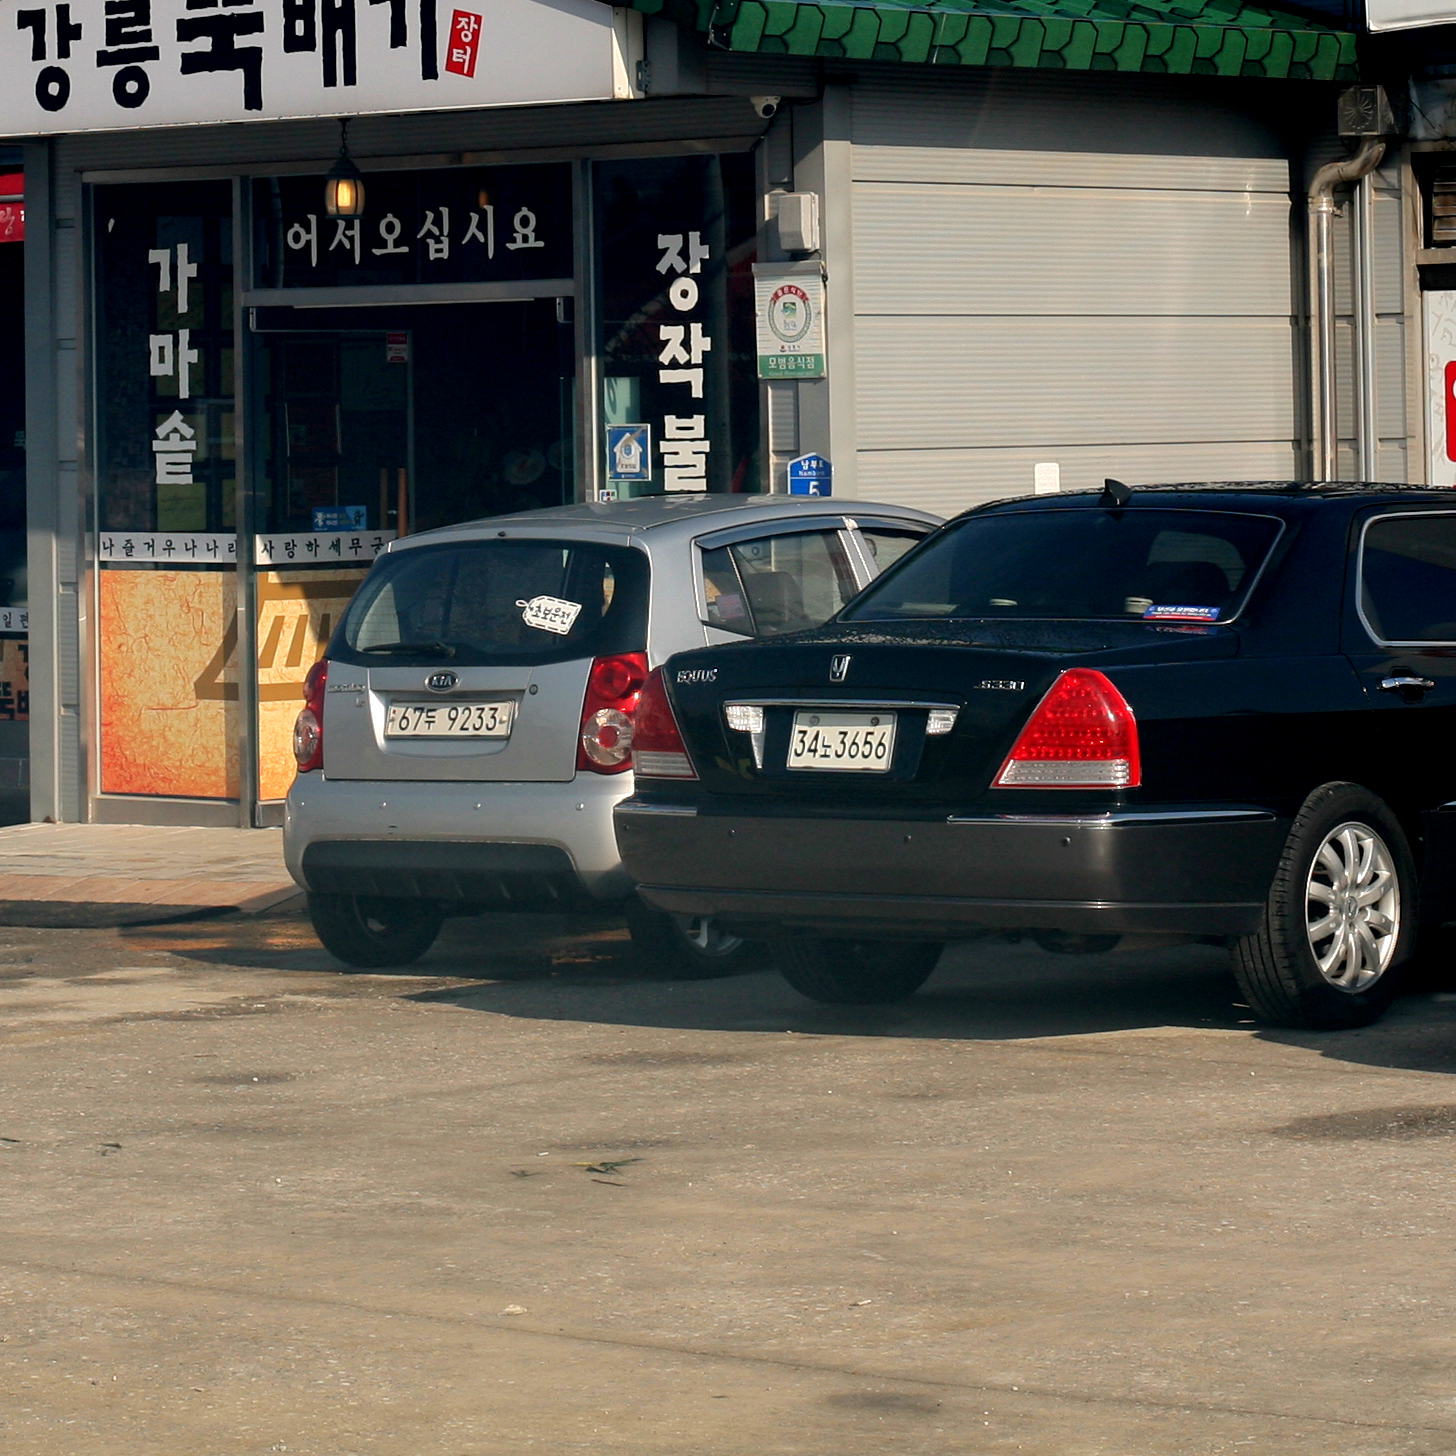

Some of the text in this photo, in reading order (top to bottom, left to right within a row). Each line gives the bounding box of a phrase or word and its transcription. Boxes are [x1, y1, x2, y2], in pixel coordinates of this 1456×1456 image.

[451, 14, 479, 75] 장터
[148, 242, 198, 486] 가마솥
[656, 231, 711, 493] 장작불
[768, 355, 815, 369] 모범음식점
[531, 603, 571, 626] 초보운전
[430, 676, 452, 687] KIA
[676, 667, 719, 685] EQUUS
[398, 706, 498, 732] 67두 9233
